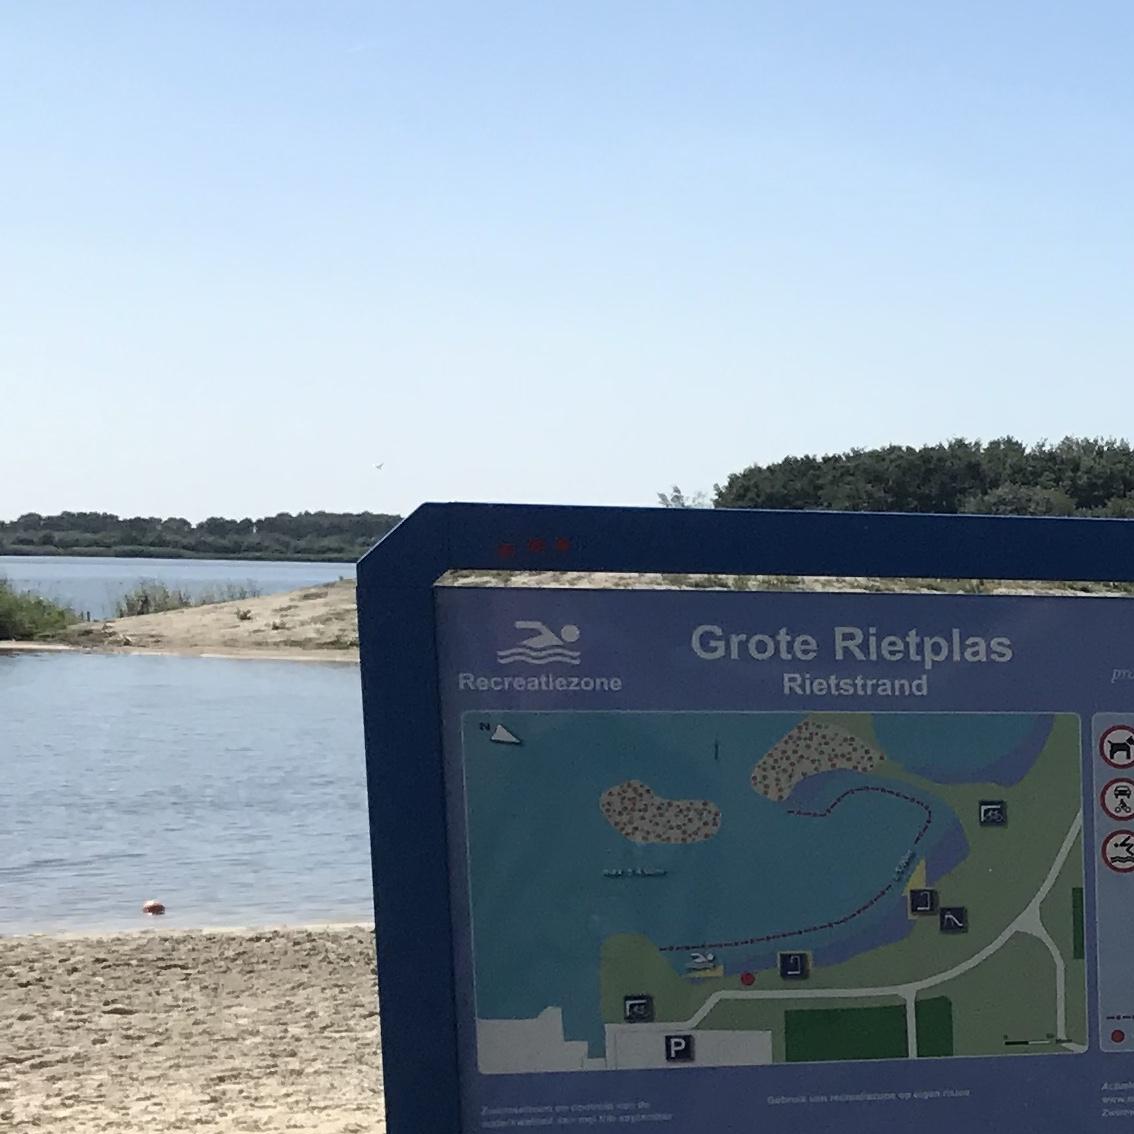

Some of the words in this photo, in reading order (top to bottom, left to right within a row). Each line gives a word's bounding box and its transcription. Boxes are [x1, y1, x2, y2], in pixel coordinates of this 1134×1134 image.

[690, 624, 818, 661] Grote
[834, 626, 1013, 669] Rietplas
[457, 672, 623, 693] Recreatiezone
[782, 673, 928, 698] Rietstrand
[670, 1038, 686, 1057] P
